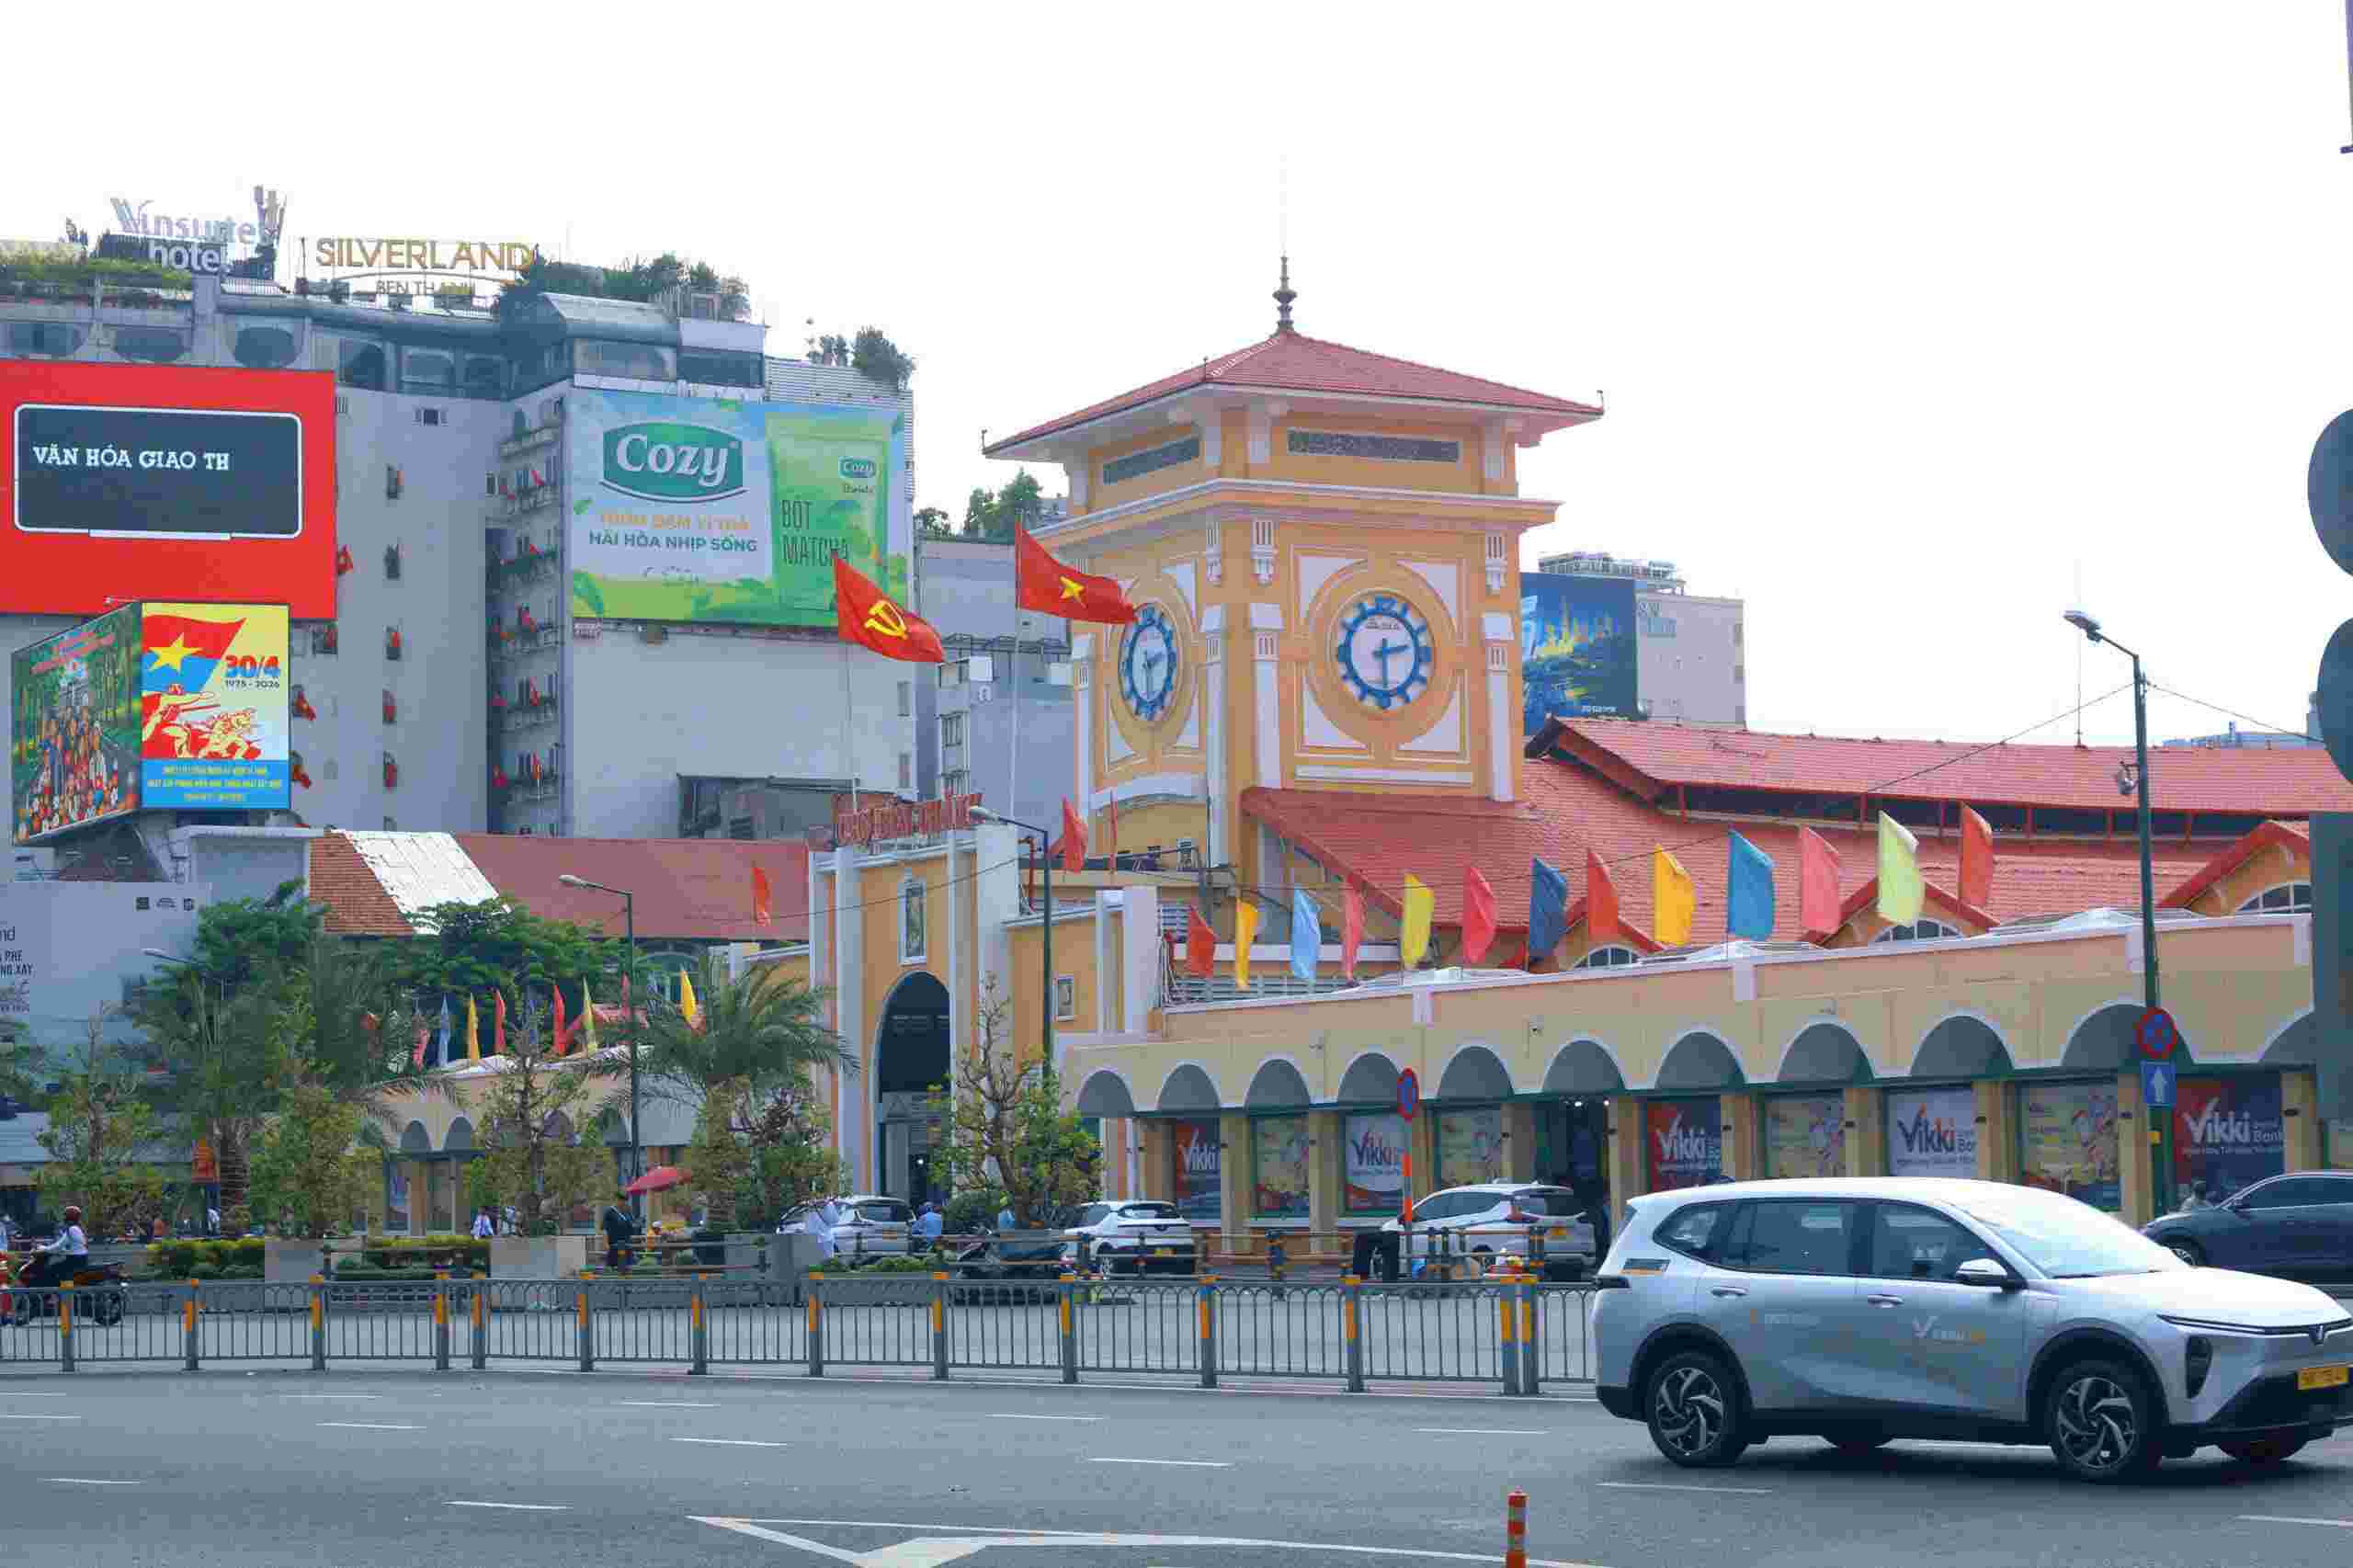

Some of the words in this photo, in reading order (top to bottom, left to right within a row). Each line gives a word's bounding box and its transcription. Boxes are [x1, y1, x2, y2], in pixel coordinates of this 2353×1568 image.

[149, 238, 229, 273] hotel
[316, 237, 533, 270] SILVERLAND
[33, 443, 79, 466] VĂN
[85, 444, 132, 468] HÓA
[139, 450, 197, 470] GIAO
[203, 452, 230, 471] TH
[617, 434, 728, 486] Cozy
[666, 536, 707, 551] NHỊP
[225, 654, 280, 678] 30/4
[1657, 1110, 1706, 1161] Vikki
[1897, 1103, 1956, 1153] Vikki
[2181, 1096, 2250, 1142] Vikki
[1178, 1128, 1217, 1173] Vikki
